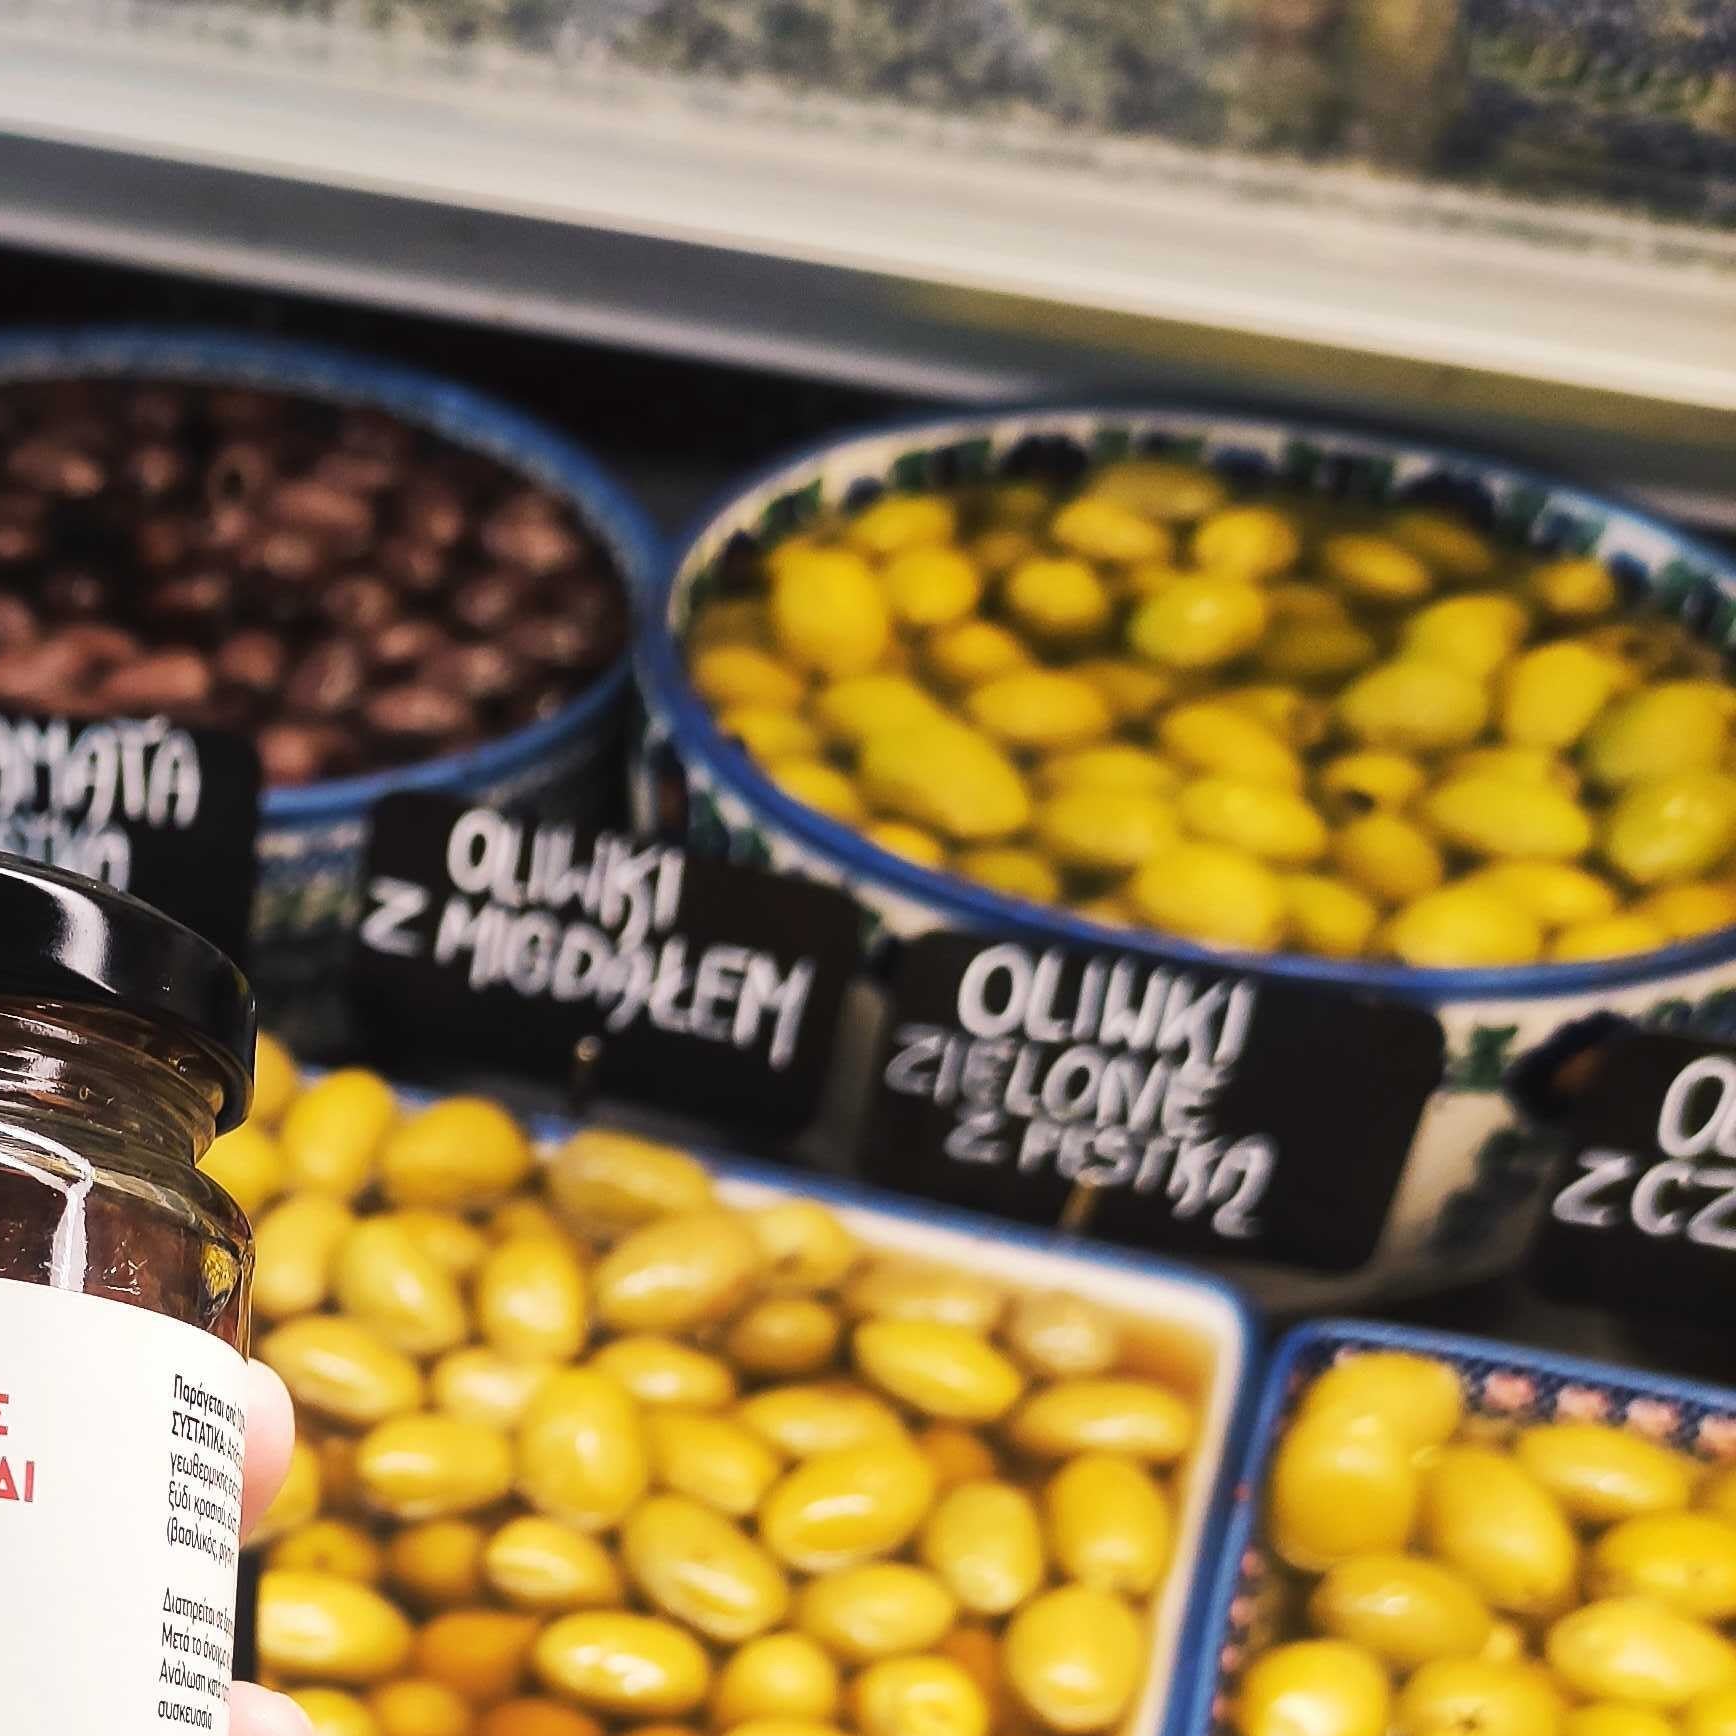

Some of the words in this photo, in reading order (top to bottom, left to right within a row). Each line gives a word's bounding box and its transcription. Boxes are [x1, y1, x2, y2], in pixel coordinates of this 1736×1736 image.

[446, 807, 687, 953] OLIWKI
[360, 876, 431, 957] Z
[957, 942, 1258, 1070] OLIWKI
[884, 1023, 1234, 1138] ZIELONE
[1552, 1148, 1635, 1226] Z
[173, 1373, 225, 1418] Παράγεται
[168, 1480, 191, 1511] ξύδι
[161, 1621, 190, 1652] Μετά
[192, 1635, 202, 1655] το
[158, 1656, 206, 1693] Ανάλωση
[157, 1698, 213, 1730] συσκευασία
